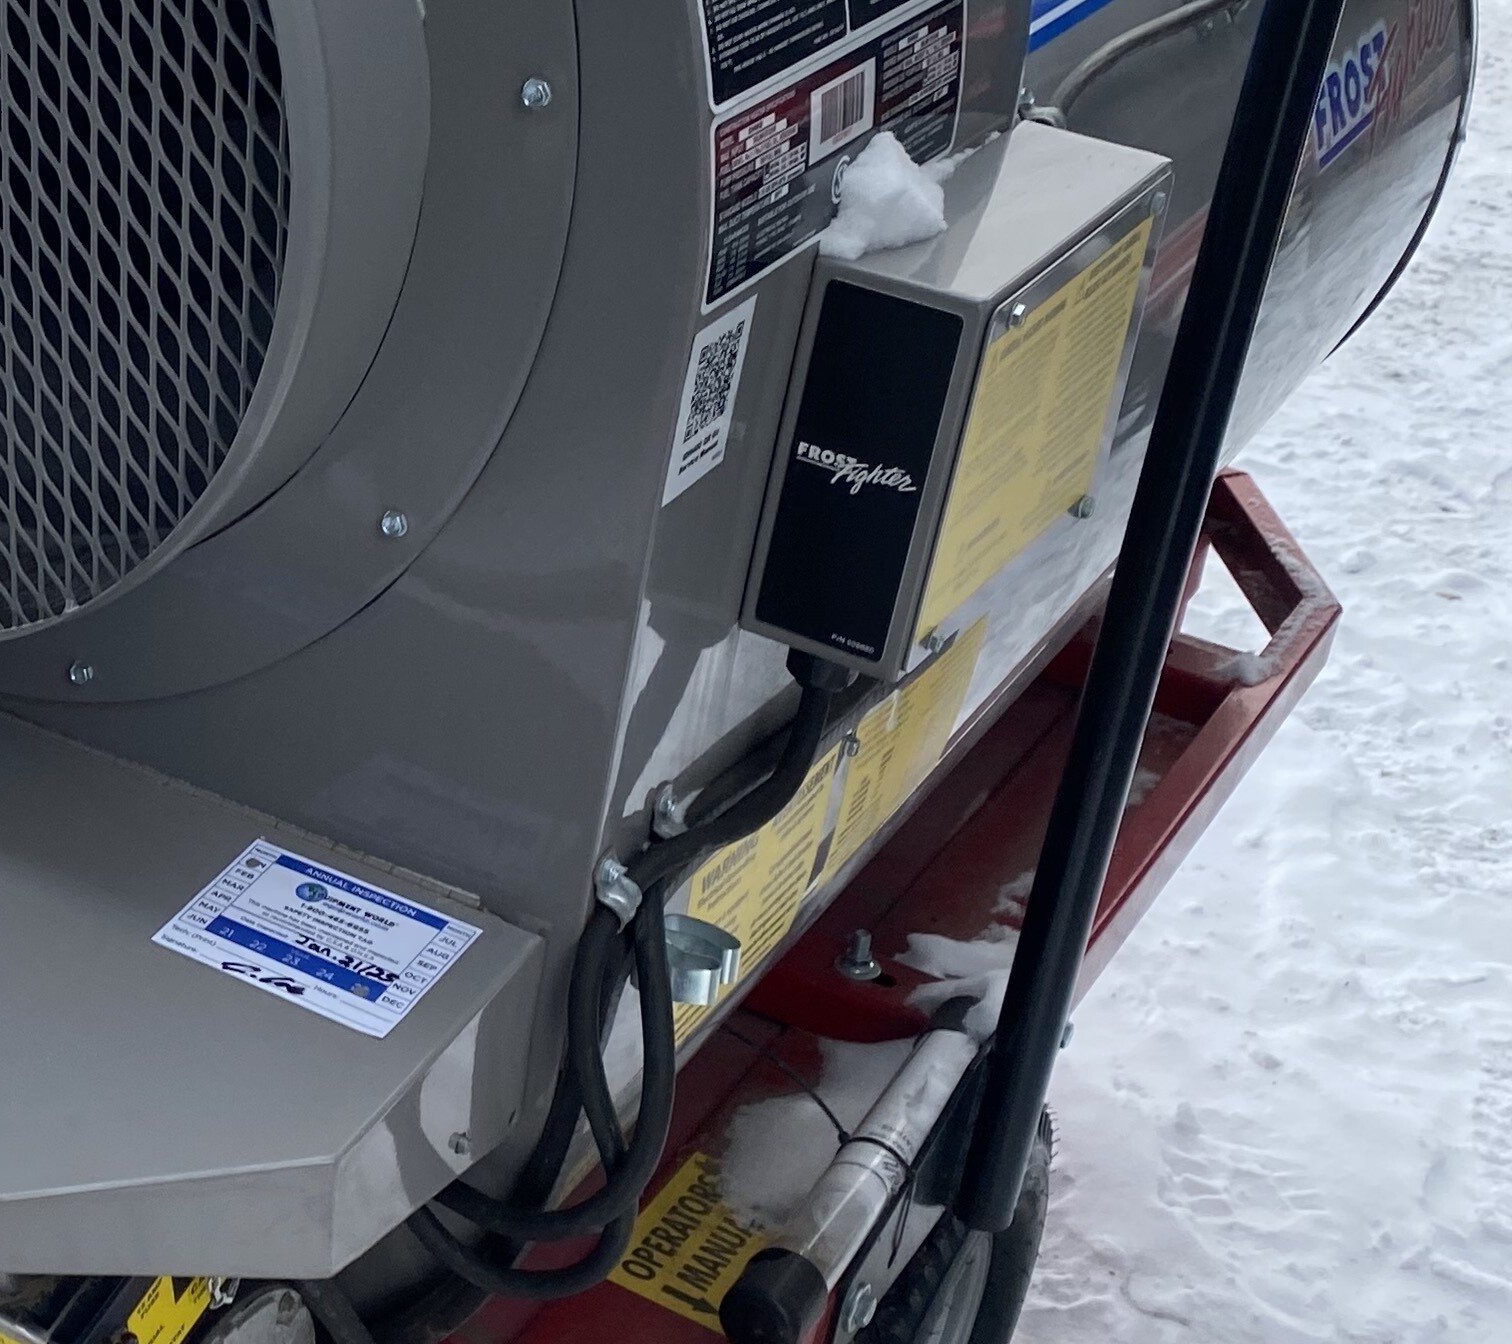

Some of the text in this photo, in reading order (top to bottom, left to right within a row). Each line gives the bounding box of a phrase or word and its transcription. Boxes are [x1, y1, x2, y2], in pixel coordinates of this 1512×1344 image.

[1314, 30, 1386, 151] FROST
[797, 441, 917, 495] FROST Fighter
[235, 868, 255, 880] FEB
[222, 878, 245, 892] MAR
[211, 890, 232, 903] APR
[305, 866, 348, 890] ANNUAL
[351, 884, 418, 918] INSPECTION
[198, 901, 221, 914] MAY
[186, 913, 208, 926] JUN
[364, 911, 396, 928] WORLD
[249, 940, 267, 952] 22
[438, 936, 458, 948] JUL
[426, 947, 450, 960] AUG
[417, 959, 438, 972] SEP
[316, 968, 335, 981] 24
[404, 971, 428, 985] OCT
[392, 982, 417, 996] NOV
[381, 995, 405, 1009] DEC
